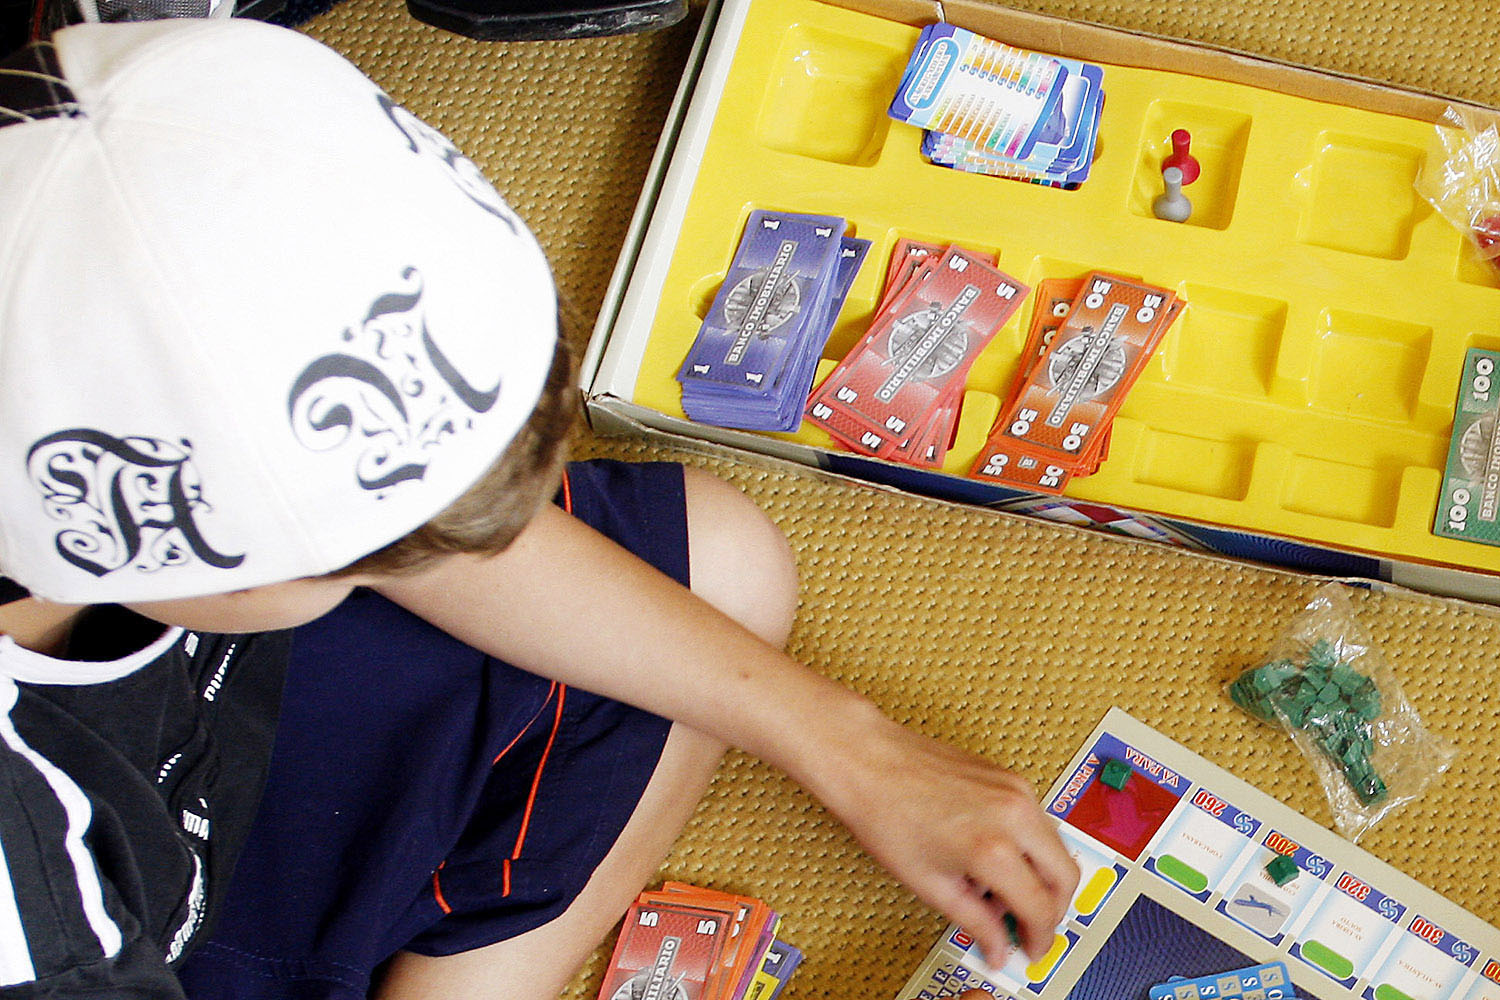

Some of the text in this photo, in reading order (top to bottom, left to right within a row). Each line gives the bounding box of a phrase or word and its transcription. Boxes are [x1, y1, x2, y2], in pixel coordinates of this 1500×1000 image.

[764, 216, 779, 229] 1
[816, 224, 831, 238] 1
[948, 254, 967, 273] 5
[729, 242, 792, 361] BANCO IMOBILIARIO
[996, 282, 1014, 300] 5
[1084, 278, 1110, 310] 50
[1135, 292, 1161, 324] 50
[879, 287, 975, 399] BANCO IMOBILIARIO
[693, 361, 709, 374] 1
[745, 369, 761, 382] 1
[1051, 306, 1123, 425] BANCO IMOBILIARIO
[1471, 357, 1494, 399] 100
[837, 386, 856, 404] 5
[813, 403, 833, 420] 5
[1010, 406, 1036, 437] 50
[885, 415, 904, 433] 5
[1062, 420, 1088, 452] 50
[861, 432, 882, 449] 5
[983, 454, 1009, 476] 50
[1039, 465, 1065, 488] 50
[1482, 473, 1498, 516] BANCO
[1447, 487, 1471, 530] 100
[1123, 747, 1180, 787] VÁ PARA
[1053, 772, 1090, 813] PRISÃO
[1195, 790, 1225, 815] 260
[1267, 832, 1297, 856] 200
[1339, 874, 1369, 899] 320
[639, 909, 658, 927] 5
[697, 917, 716, 936] 5
[1412, 918, 1443, 942] 300
